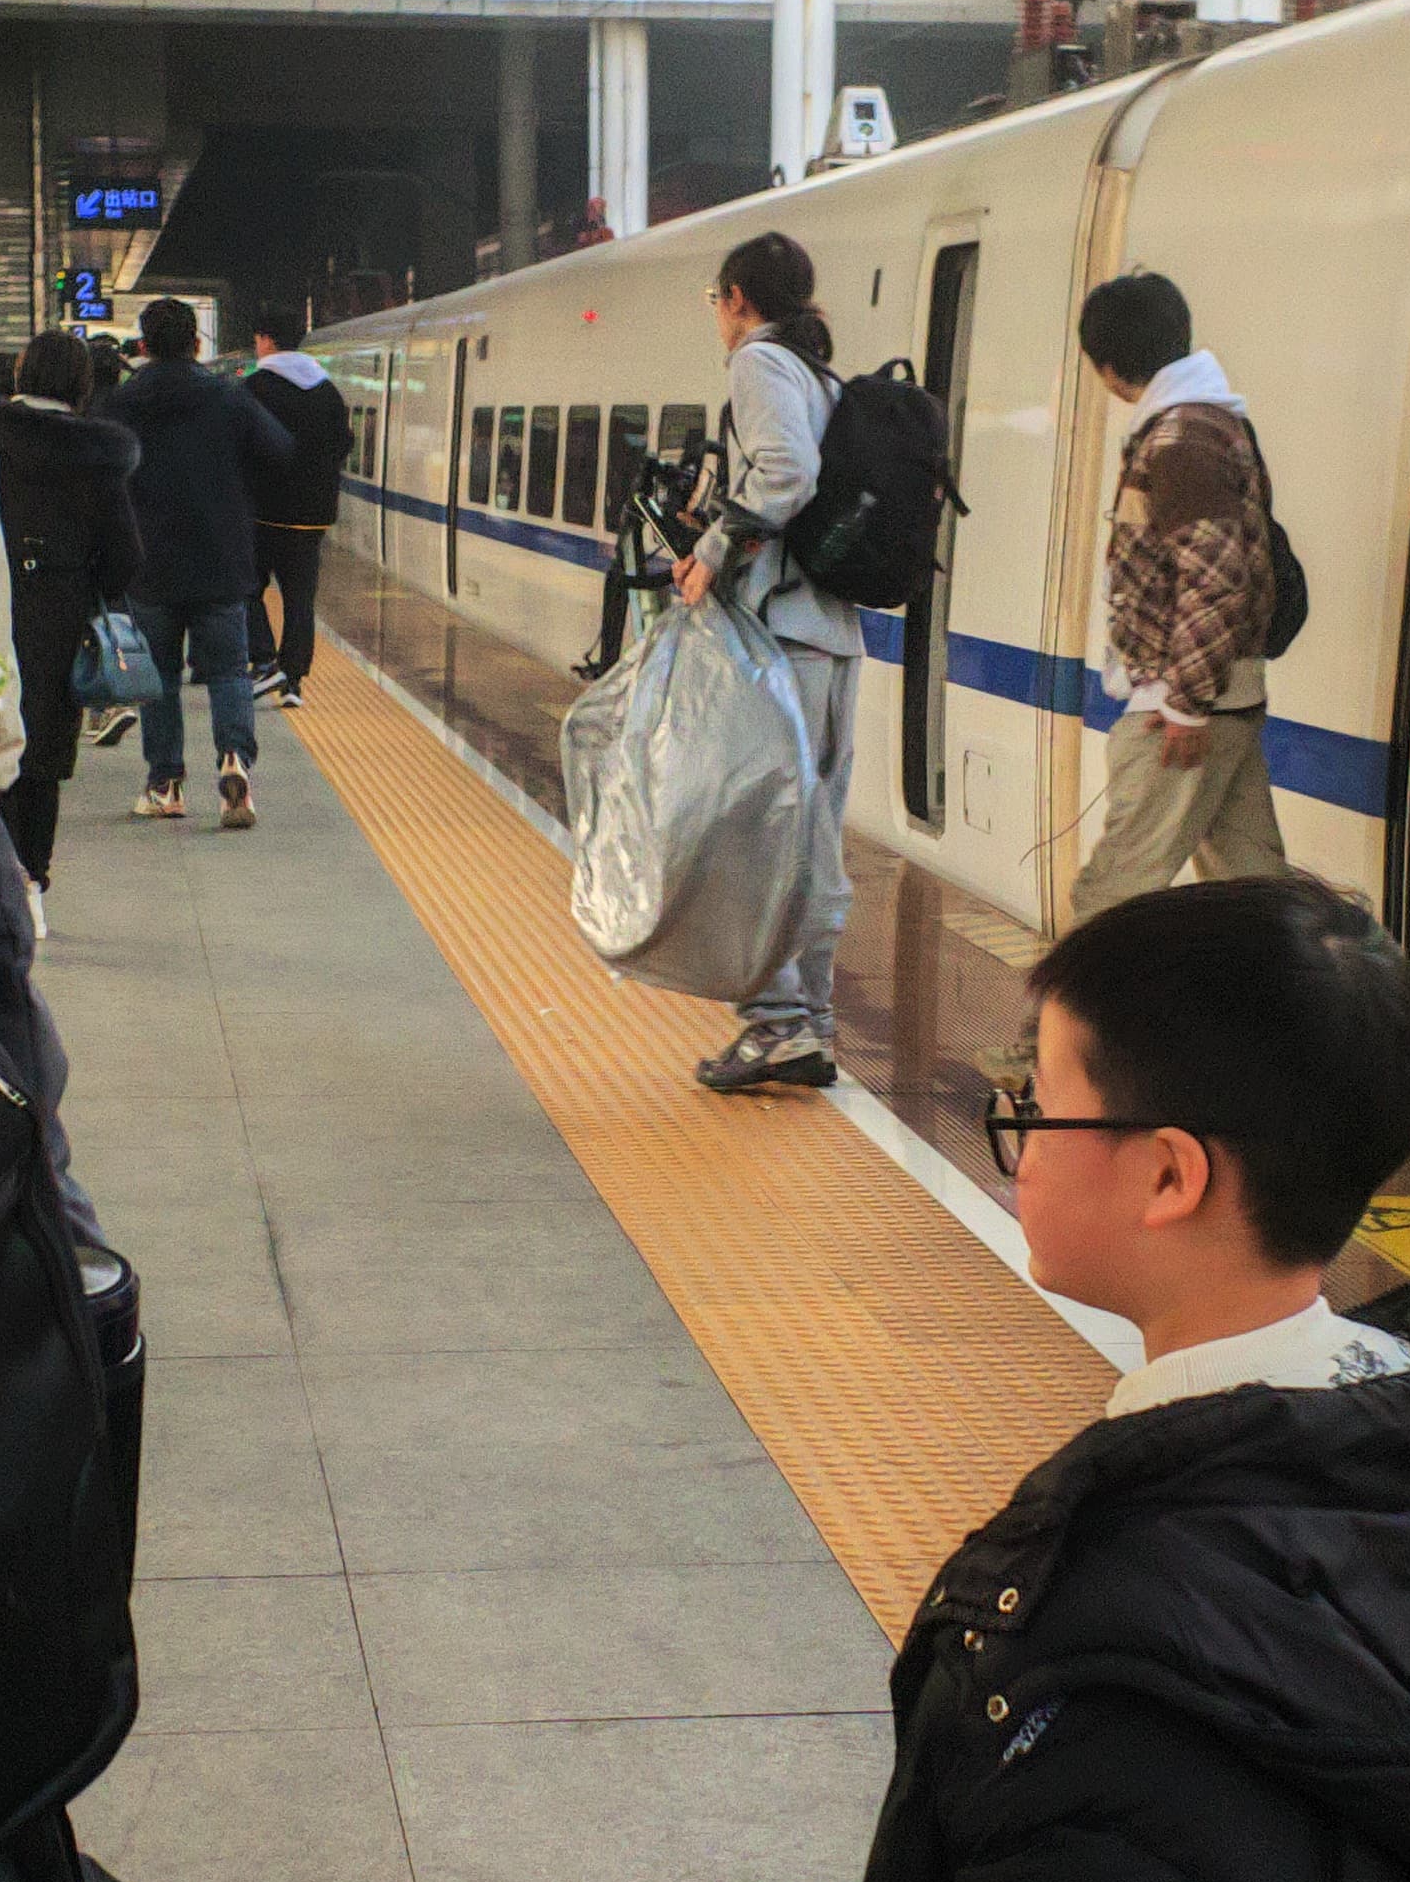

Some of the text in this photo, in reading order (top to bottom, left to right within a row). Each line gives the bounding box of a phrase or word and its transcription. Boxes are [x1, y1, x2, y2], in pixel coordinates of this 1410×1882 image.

[104, 190, 157, 209] 出站口
[76, 272, 95, 301] 2
